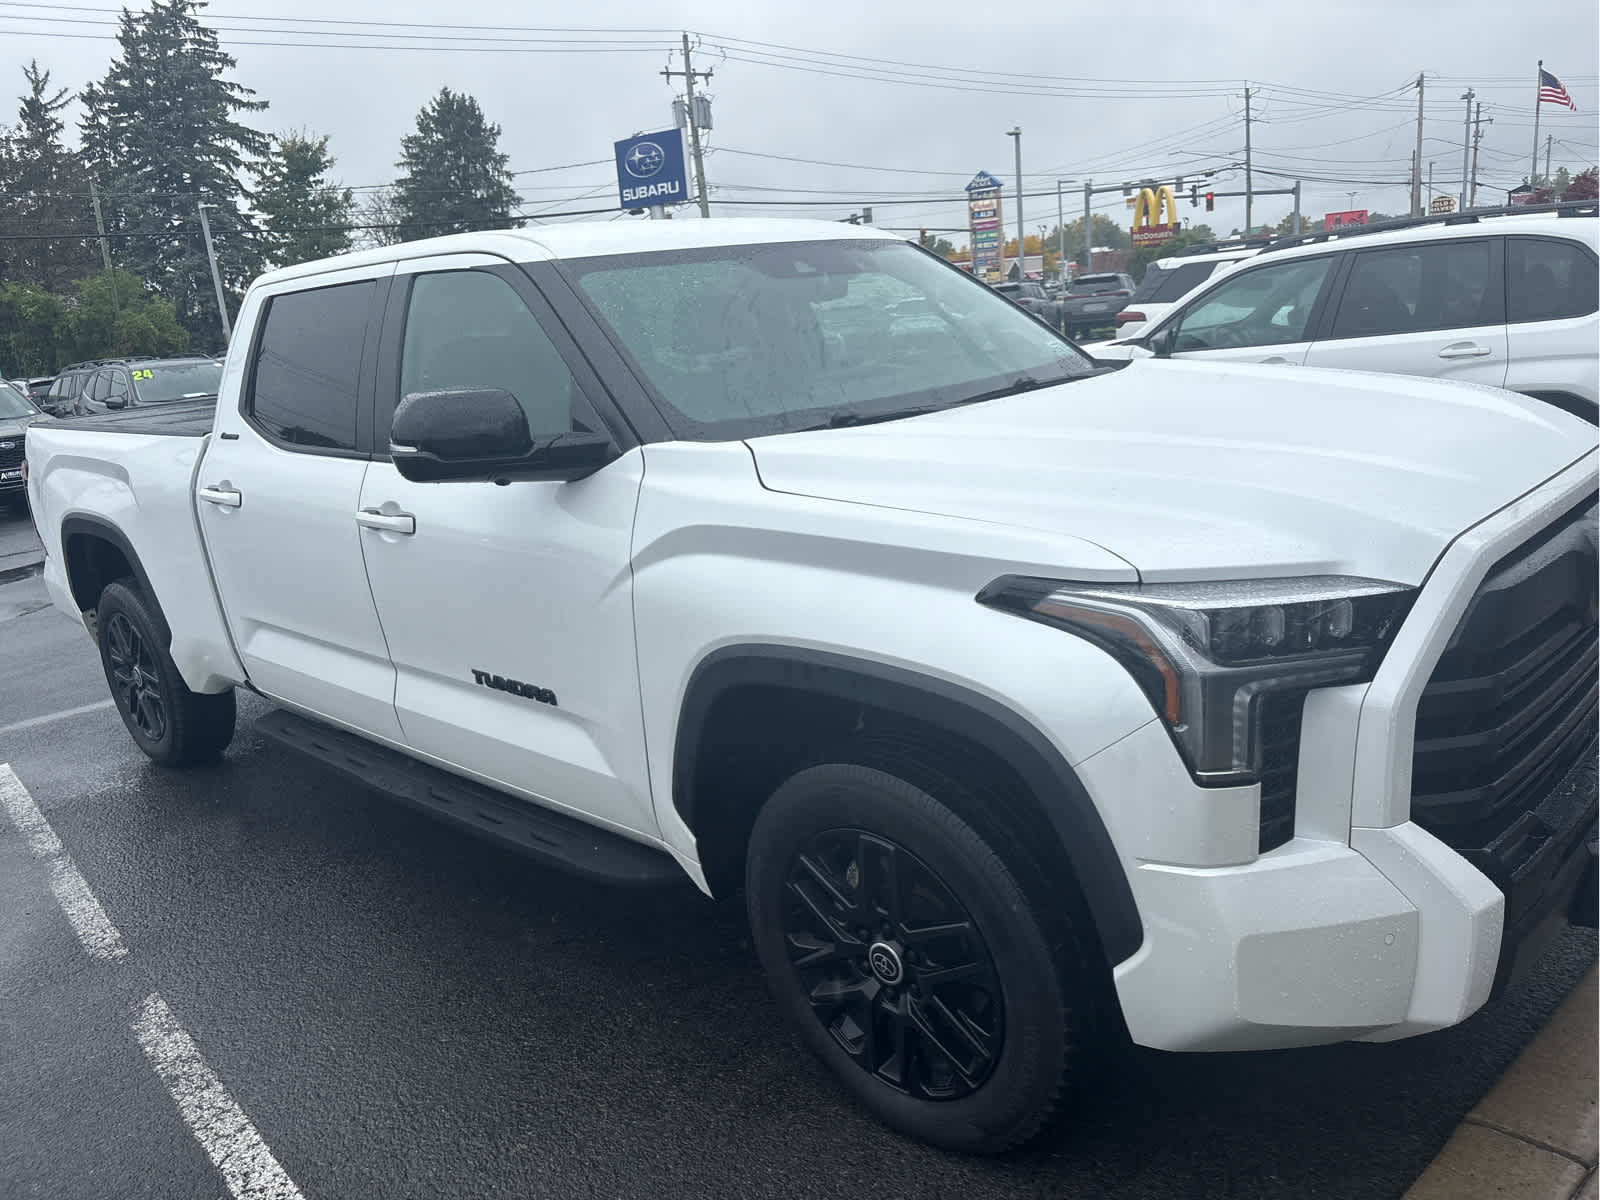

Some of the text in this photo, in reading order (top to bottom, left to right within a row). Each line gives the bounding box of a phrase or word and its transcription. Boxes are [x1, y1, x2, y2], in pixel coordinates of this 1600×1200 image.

[623, 181, 680, 201] SUBARU
[132, 369, 153, 381] 24
[471, 669, 558, 706] TUNDRA
